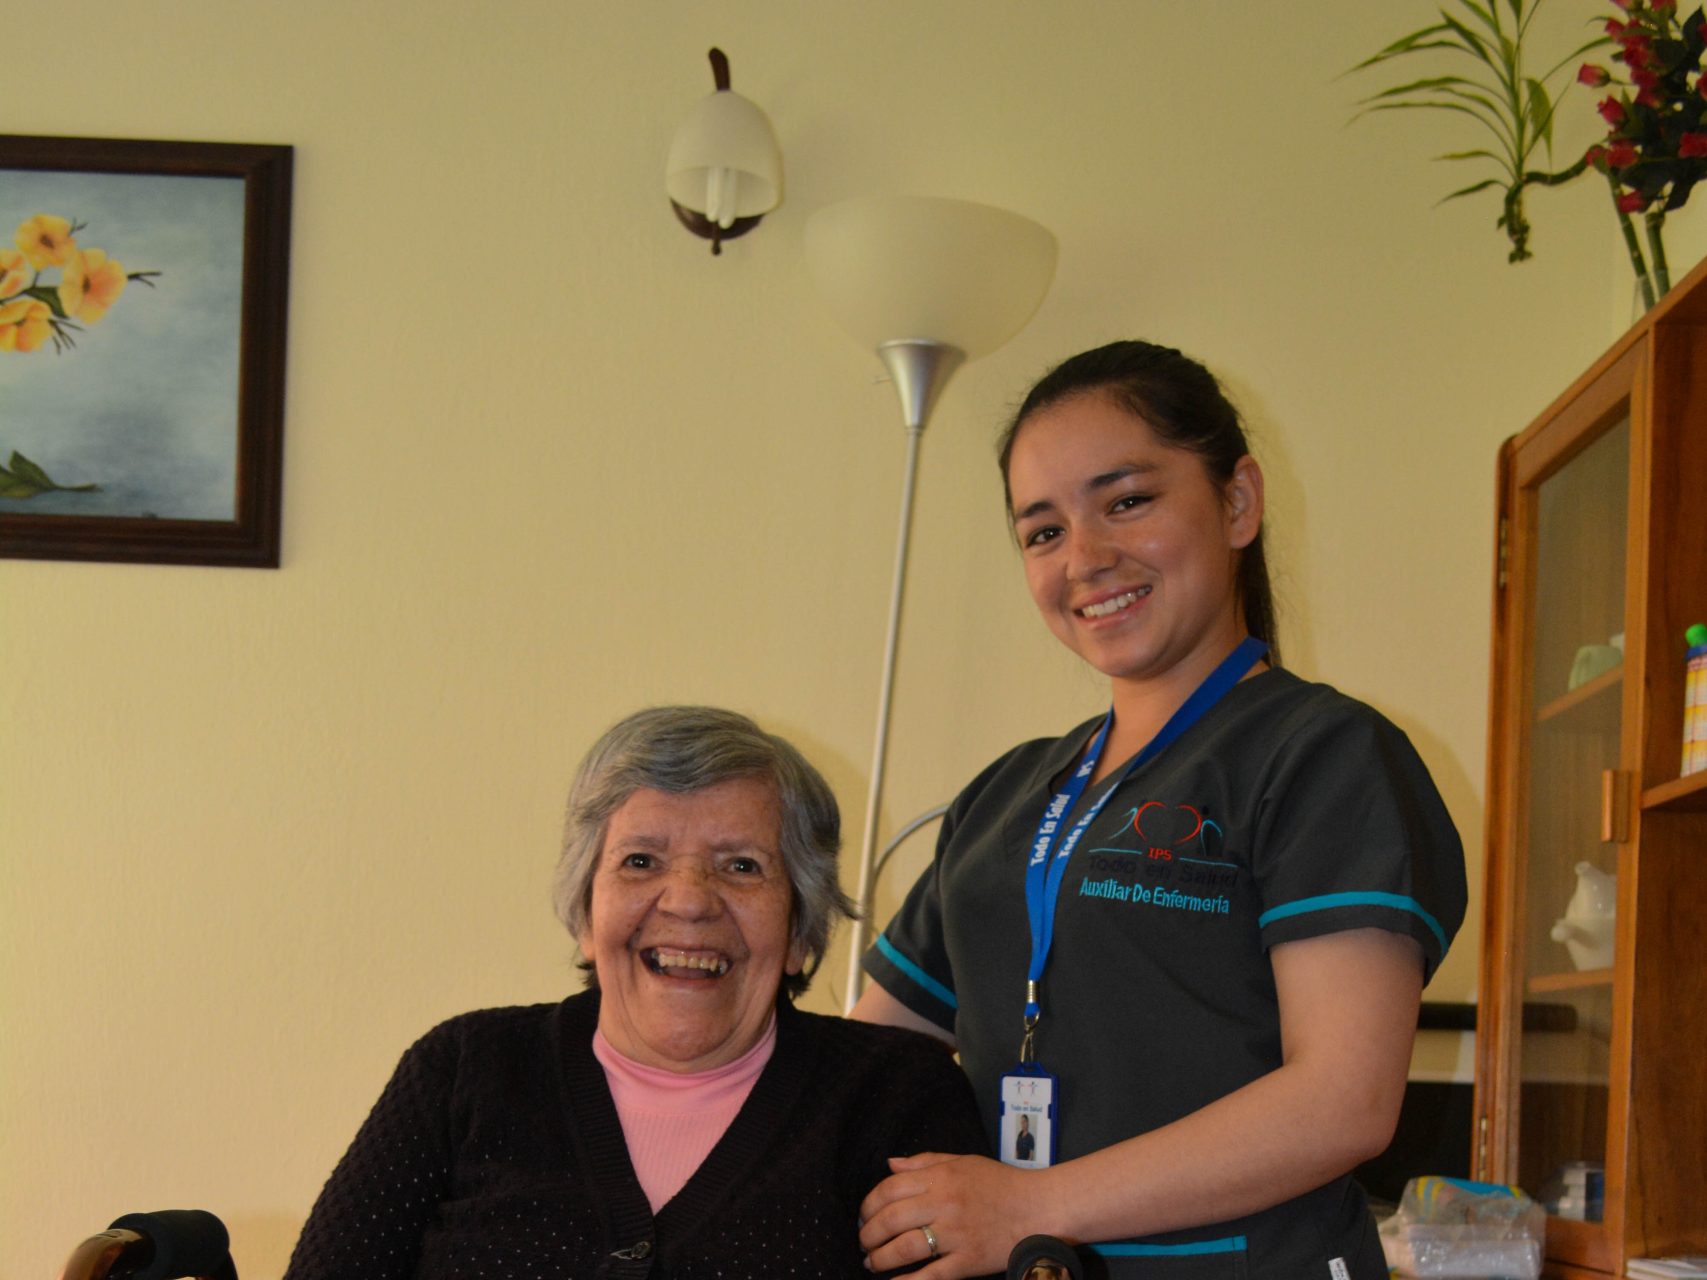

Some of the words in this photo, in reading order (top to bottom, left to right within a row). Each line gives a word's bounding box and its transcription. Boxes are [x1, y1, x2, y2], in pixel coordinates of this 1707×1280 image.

[1045, 794, 1071, 820] Salud
[1039, 821, 1057, 834] En
[1030, 836, 1050, 866] Todo
[1058, 828, 1082, 859] Todo
[1148, 847, 1172, 861] IPS
[1079, 876, 1131, 902] Auxiliar
[1132, 883, 1151, 903] De
[1153, 886, 1229, 914] Enfermería
